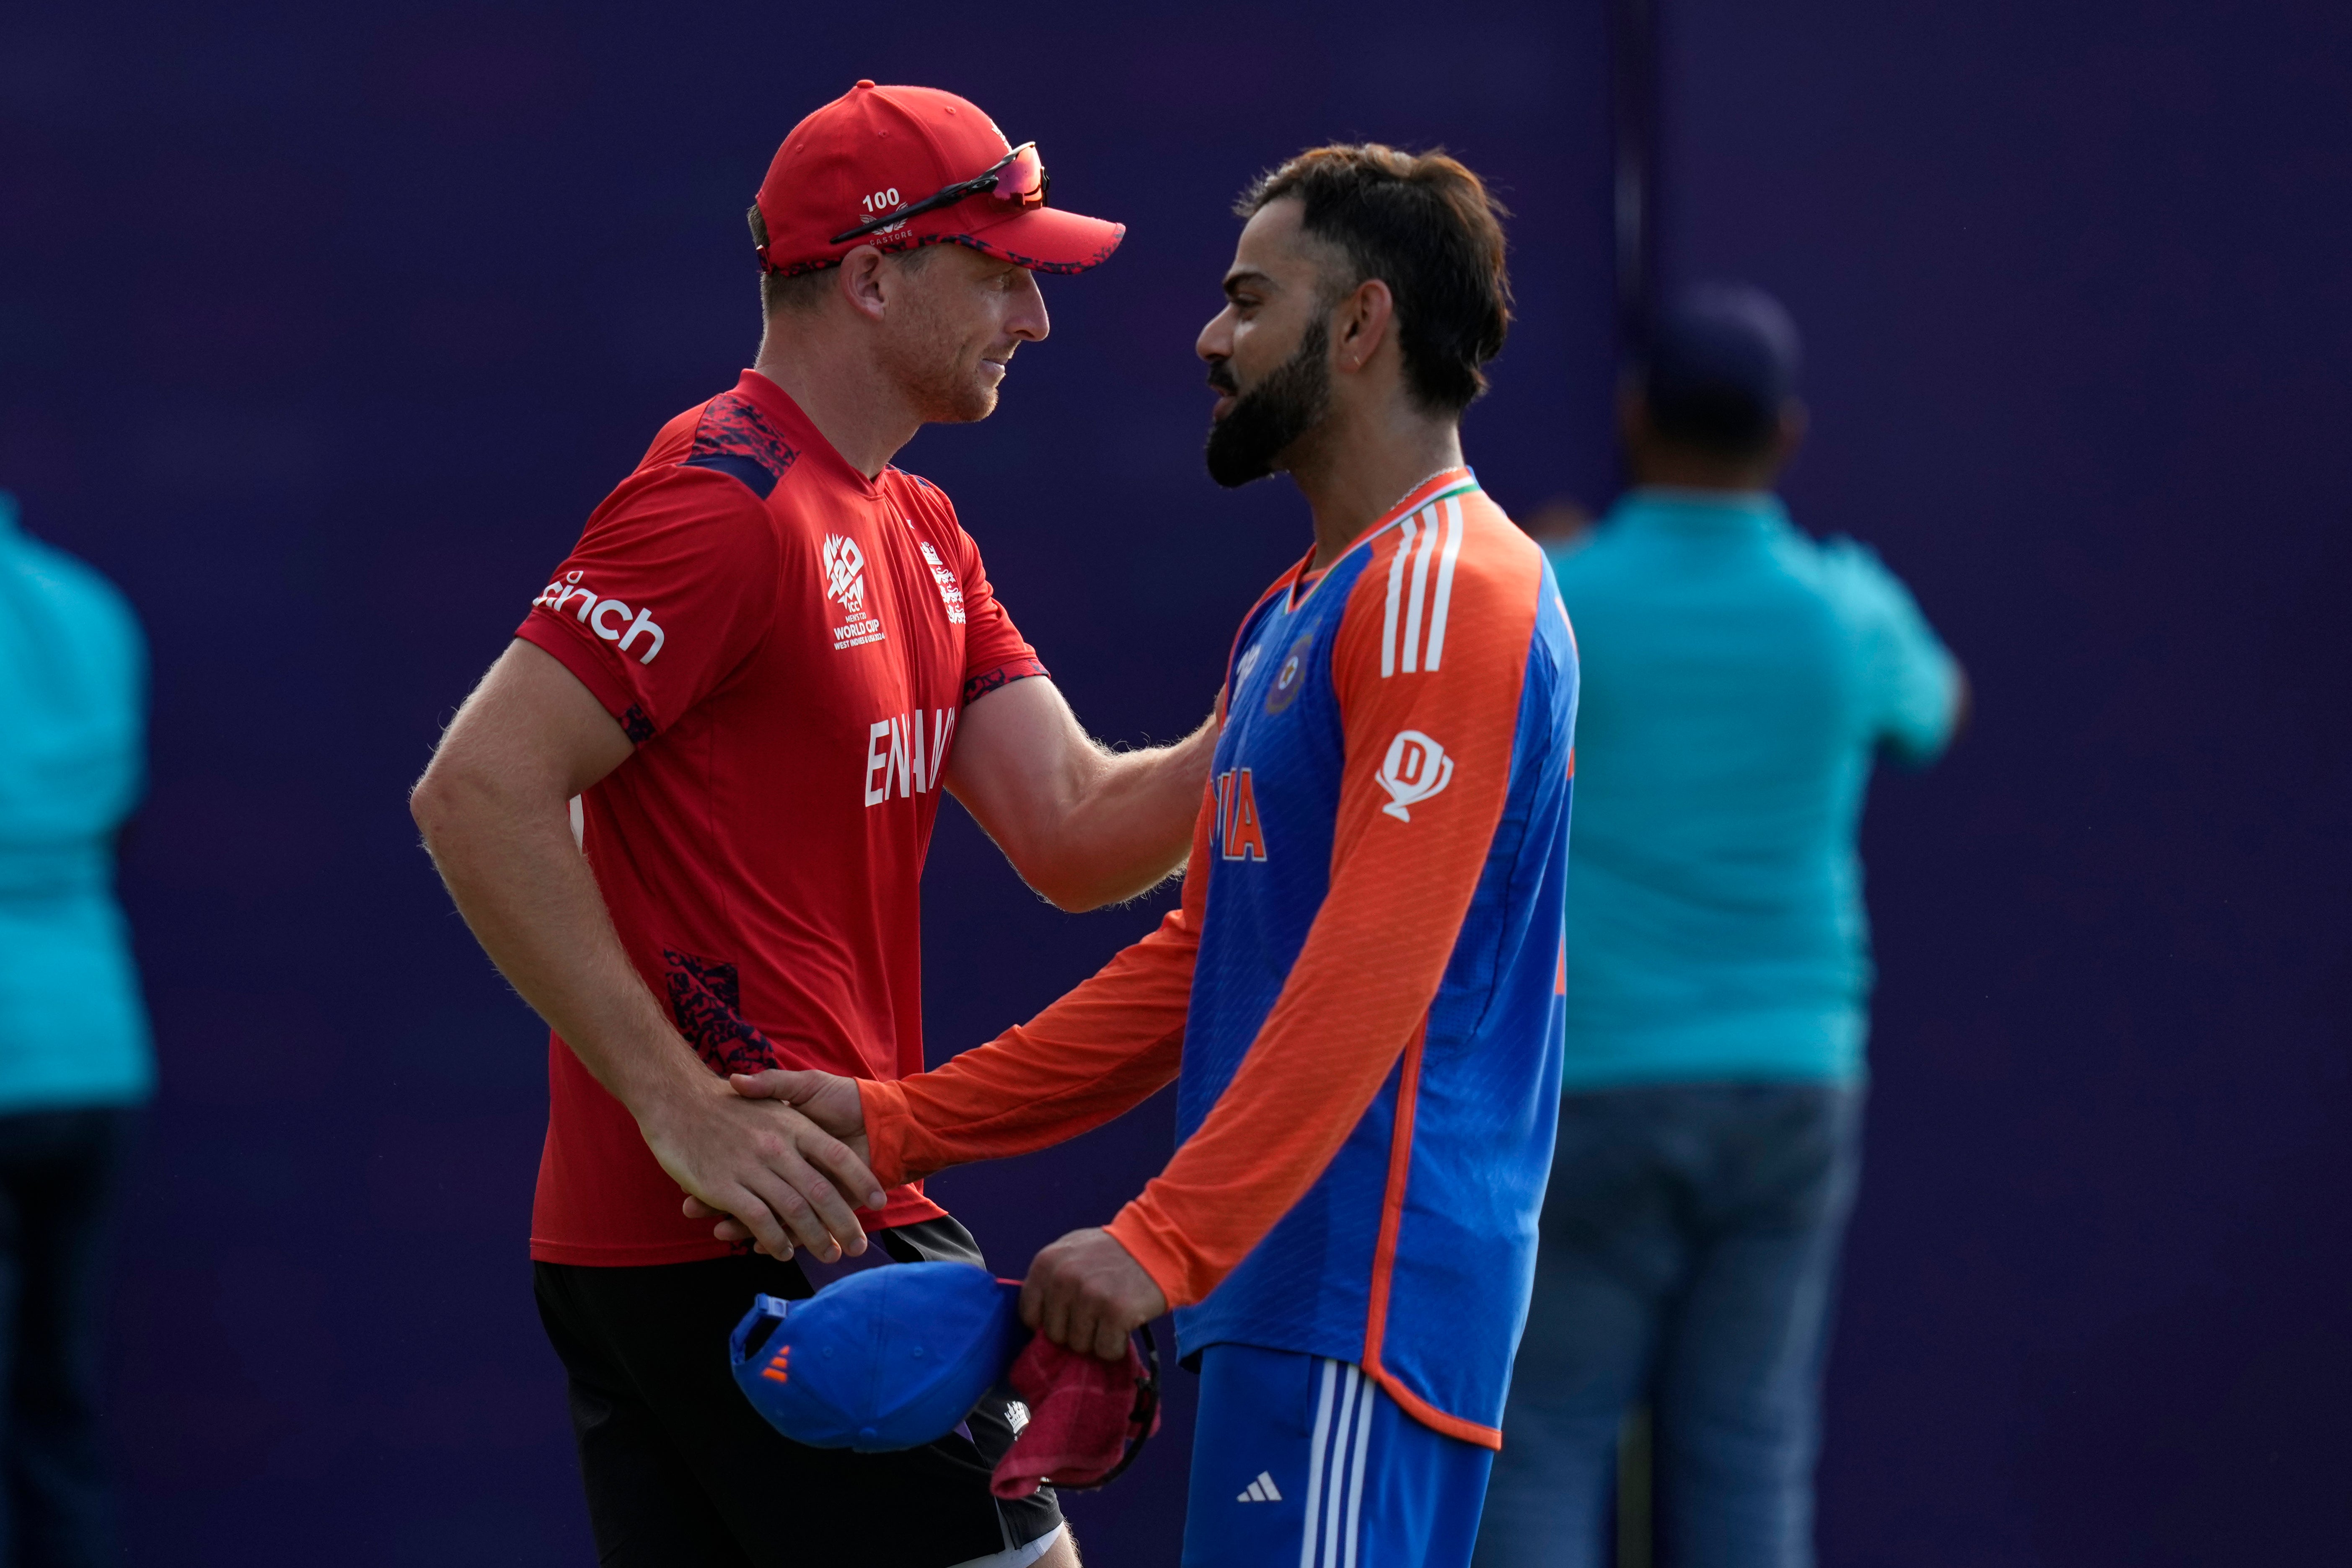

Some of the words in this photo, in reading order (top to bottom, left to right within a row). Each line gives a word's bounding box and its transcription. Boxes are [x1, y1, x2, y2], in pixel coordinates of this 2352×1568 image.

[863, 188, 899, 212] 100
[870, 230, 912, 246] CASTORE
[847, 601, 860, 613] ICC
[833, 622, 866, 641] WORLD
[865, 619, 880, 633] CUP
[834, 640, 850, 650] WEST
[850, 637, 865, 647] INDIES
[867, 634, 876, 643] USA
[875, 632, 885, 641] 2024
